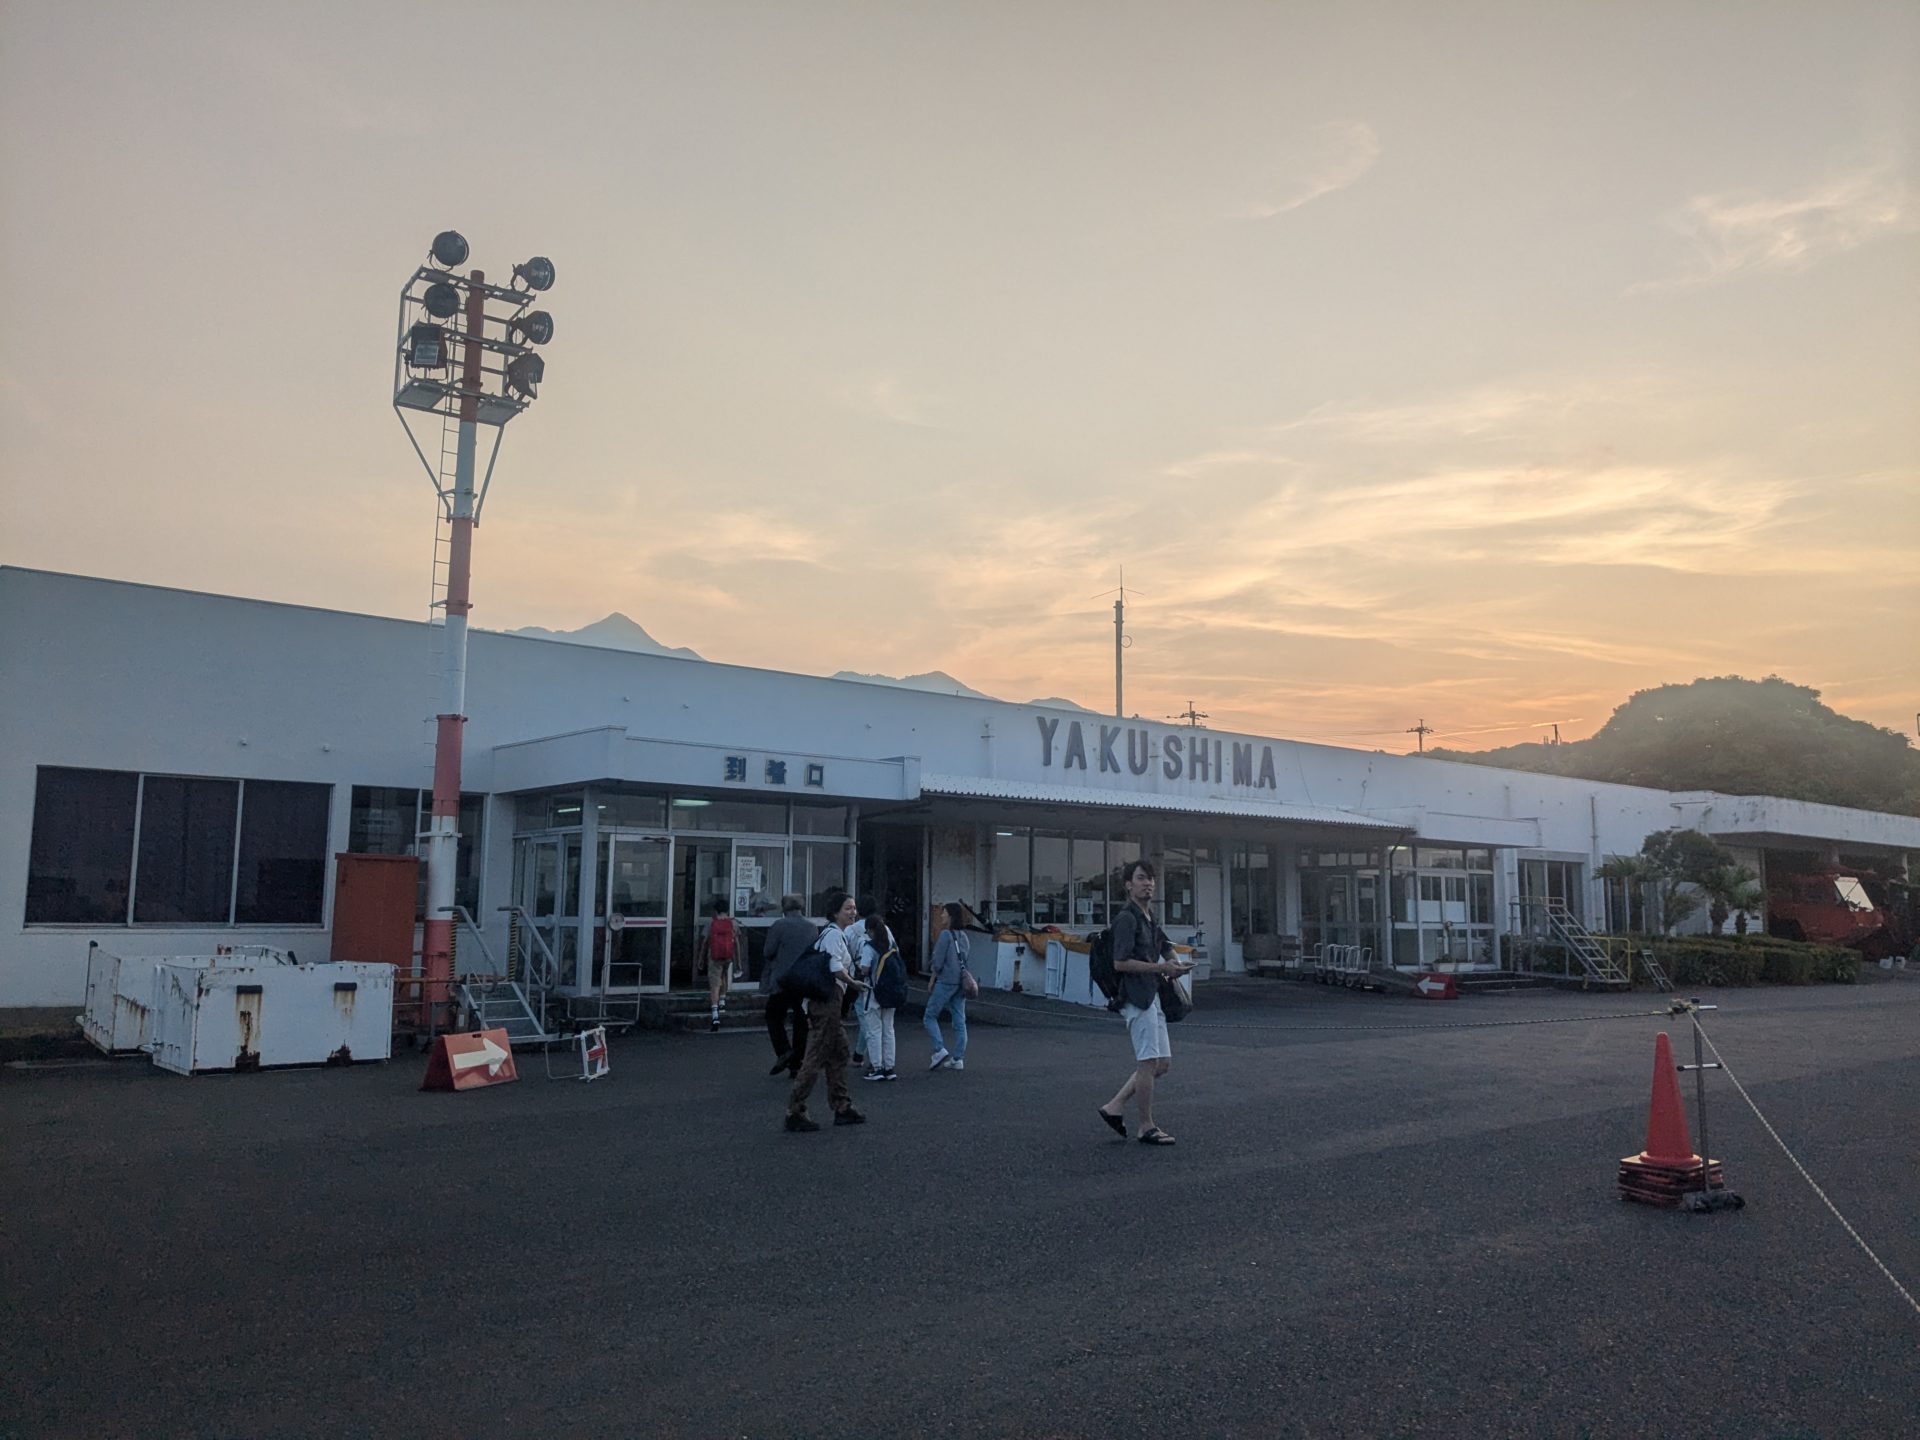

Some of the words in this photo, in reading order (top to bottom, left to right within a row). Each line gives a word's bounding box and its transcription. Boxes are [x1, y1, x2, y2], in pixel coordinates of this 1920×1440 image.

[724, 756, 824, 787] 到着口
[1036, 716, 1277, 790] YAKUSHIMA
